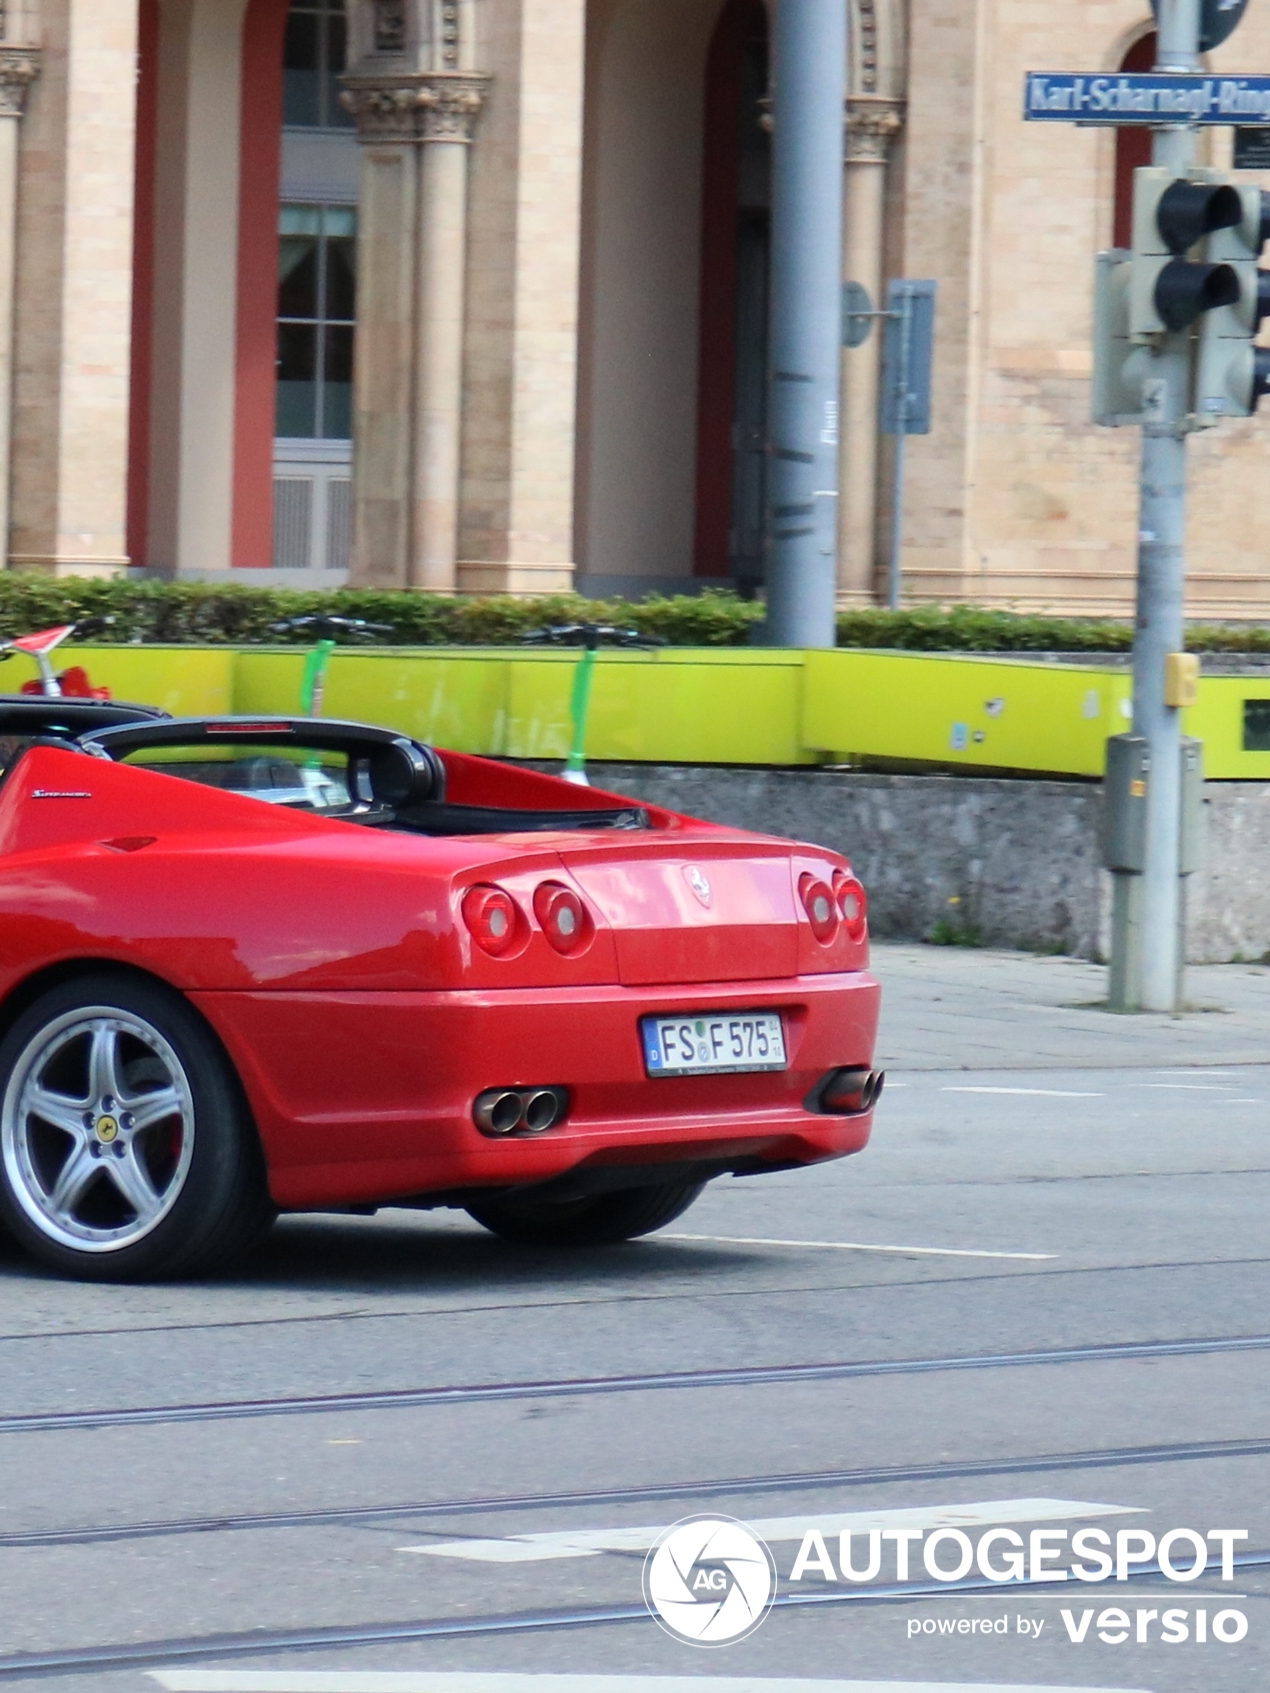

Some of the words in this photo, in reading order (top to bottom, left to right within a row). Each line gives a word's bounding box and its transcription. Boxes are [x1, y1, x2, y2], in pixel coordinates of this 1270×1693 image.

[661, 1025, 696, 1062] FS
[710, 1023, 724, 1060] F
[729, 1020, 770, 1058] 575
